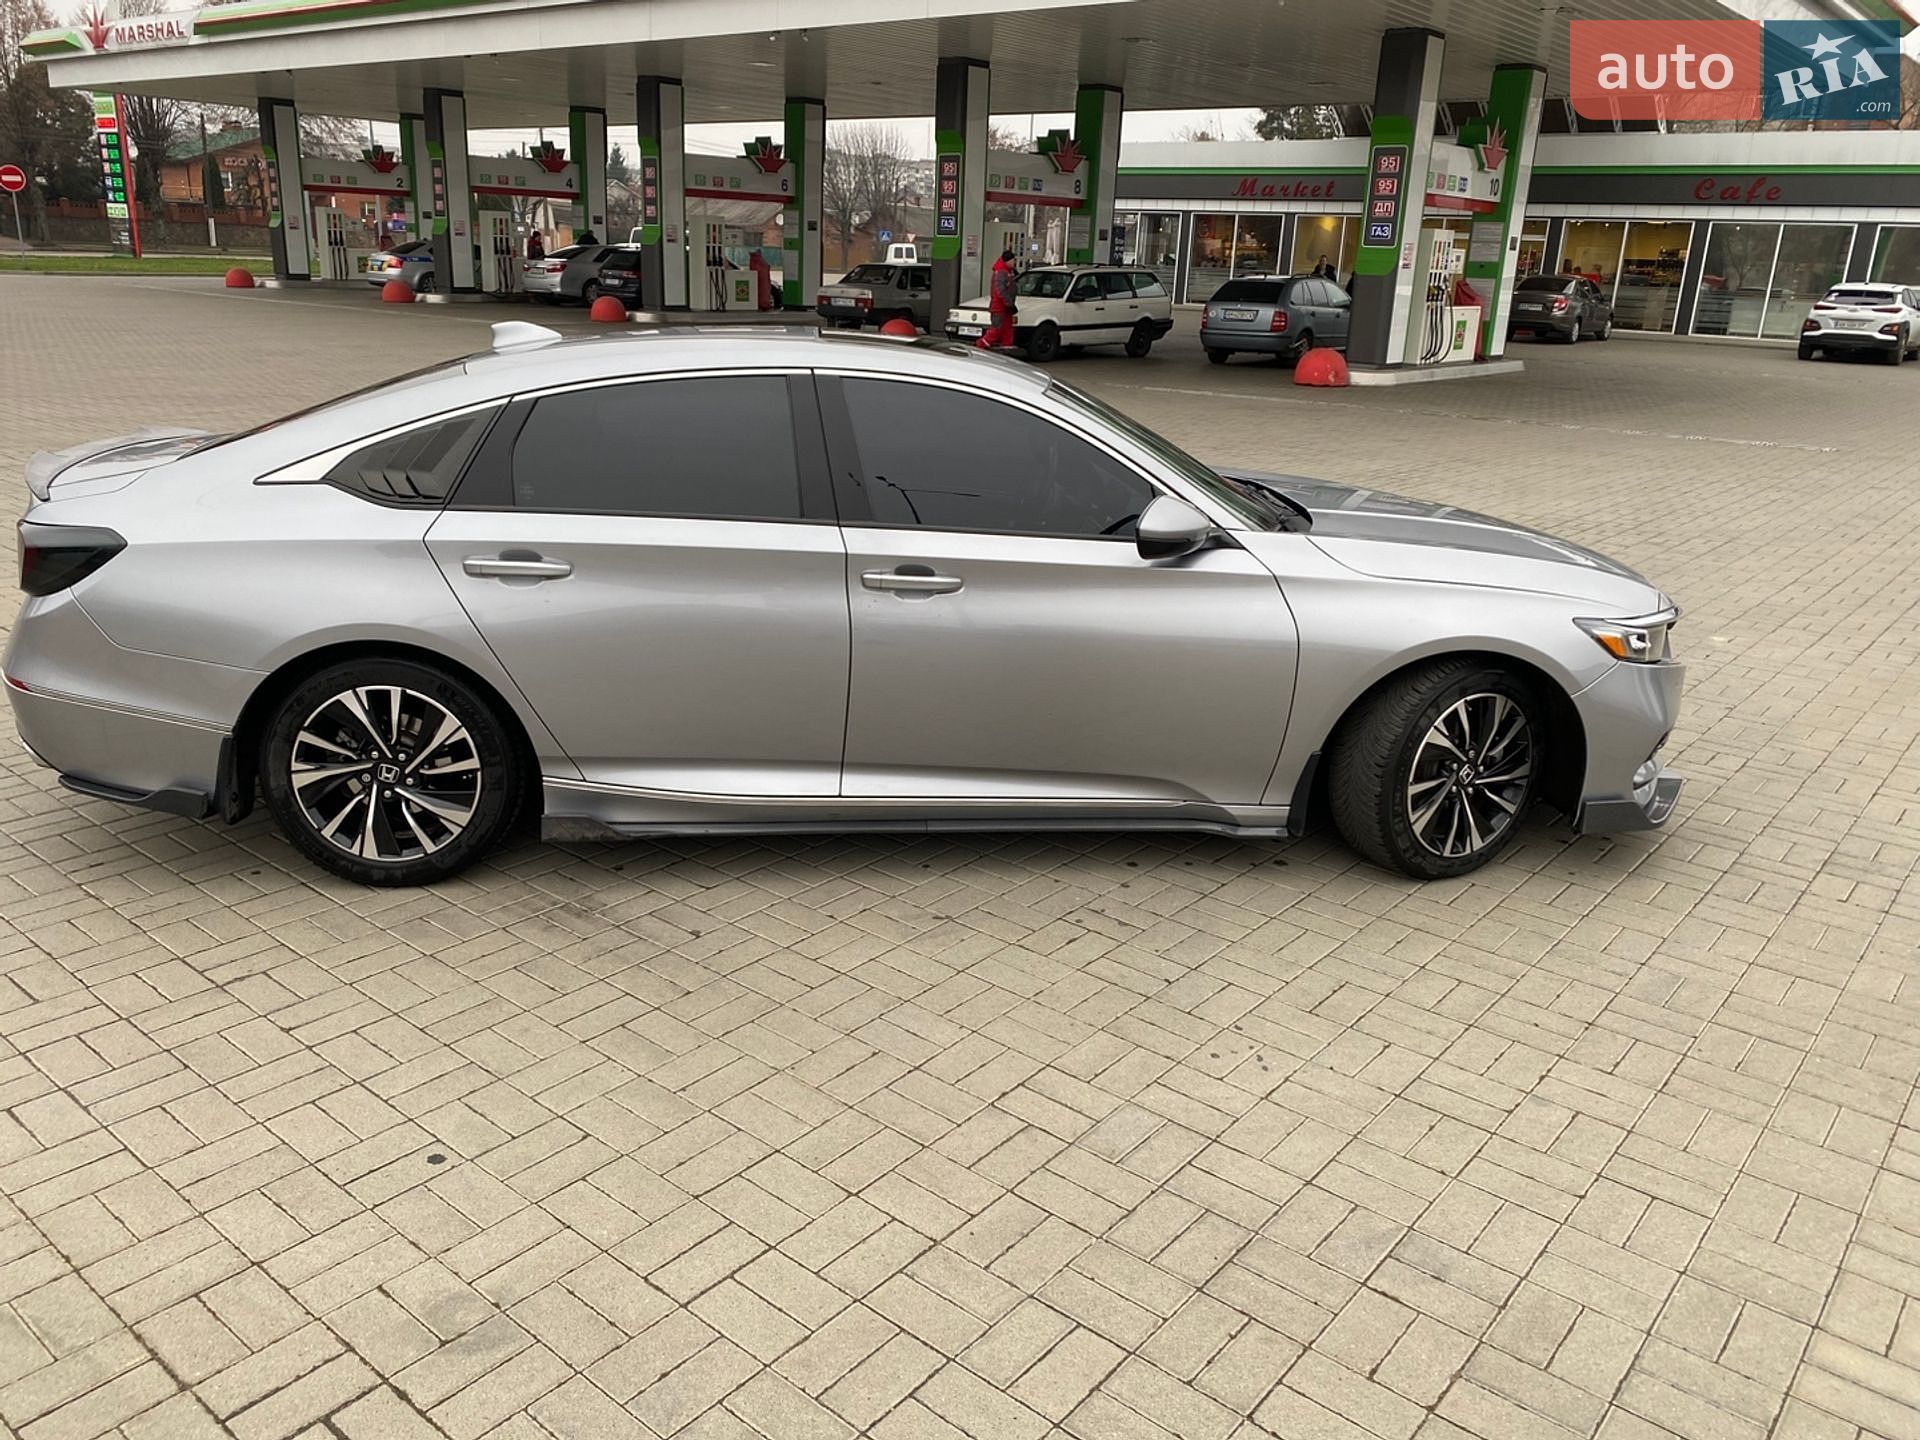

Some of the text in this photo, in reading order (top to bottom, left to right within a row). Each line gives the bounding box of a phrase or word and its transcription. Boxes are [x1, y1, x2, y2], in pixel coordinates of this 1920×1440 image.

[115, 20, 185, 44] MARSHAL
[1381, 156, 1396, 168] 95
[396, 177, 403, 188] 2
[566, 177, 574, 188] 4
[781, 179, 788, 191] 6
[1074, 179, 1082, 195] 8
[1232, 177, 1335, 197] Market
[1378, 179, 1393, 191] 95
[1490, 178, 1500, 196] 10
[1694, 177, 1782, 203] Cafe
[1370, 225, 1390, 237] ГАЗ
